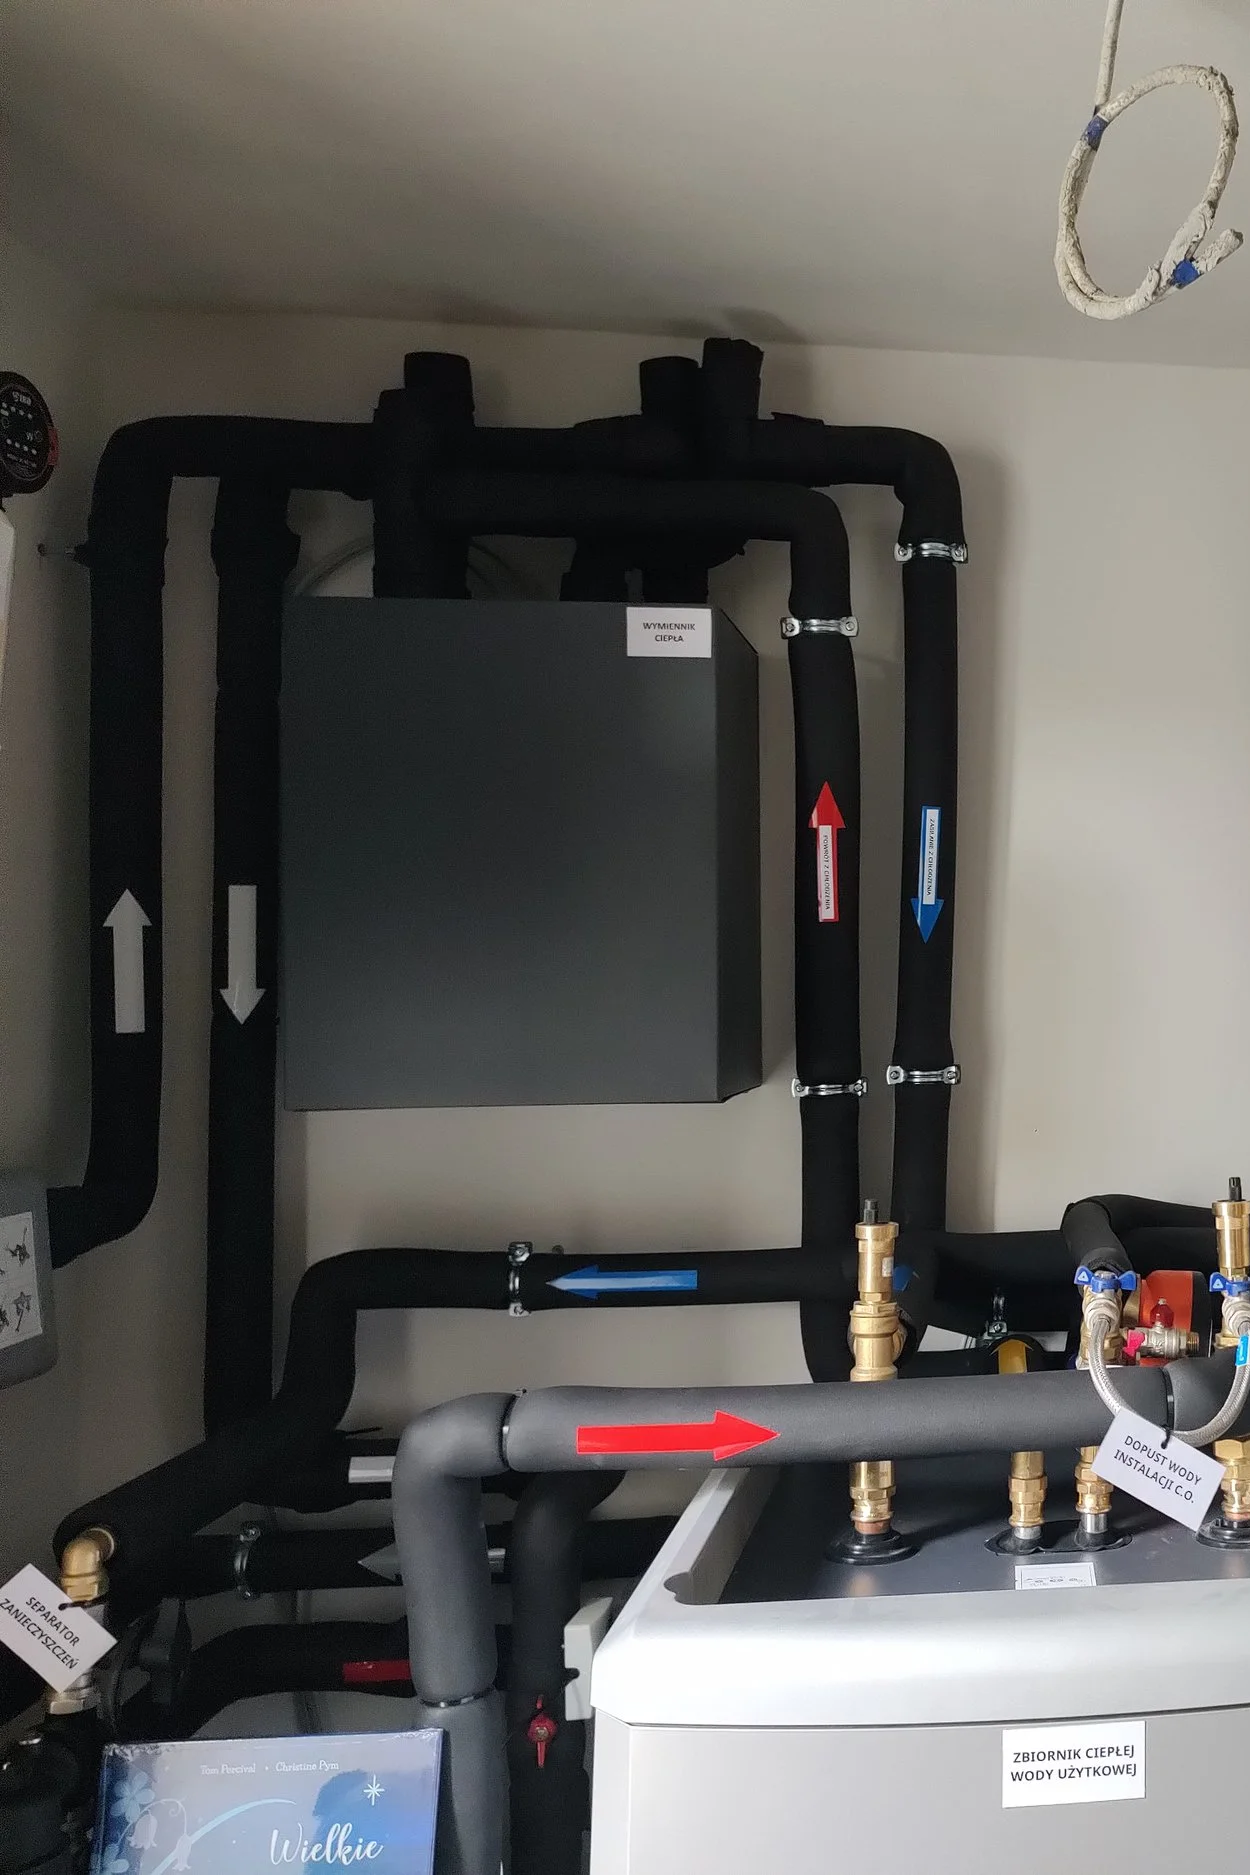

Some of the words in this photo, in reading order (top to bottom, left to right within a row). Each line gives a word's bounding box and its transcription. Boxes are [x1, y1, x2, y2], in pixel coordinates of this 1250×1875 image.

[642, 622, 696, 631] WYMIENNIK
[654, 634, 685, 642] CIEPŁA
[1124, 1435, 1168, 1466] DOPUST
[1168, 1460, 1202, 1485] WODY
[1113, 1449, 1175, 1490] INSTALACJI
[1174, 1485, 1194, 1504] C.O.
[0, 1598, 80, 1669] ZANIECZYSZCZEŃ
[26, 1596, 80, 1647] SEPARATOR
[200, 1765, 219, 1775] Tom
[221, 1763, 256, 1775] Percival
[275, 1761, 317, 1772] Christine
[319, 1759, 340, 1772] Pym
[1013, 1748, 1082, 1763] ZBIORNIK
[1085, 1744, 1135, 1759] CIEPŁEJ
[1010, 1769, 1054, 1782] WODY
[1058, 1763, 1137, 1779] UŻYTKOWEJ
[270, 1821, 385, 1866] Wielkie
